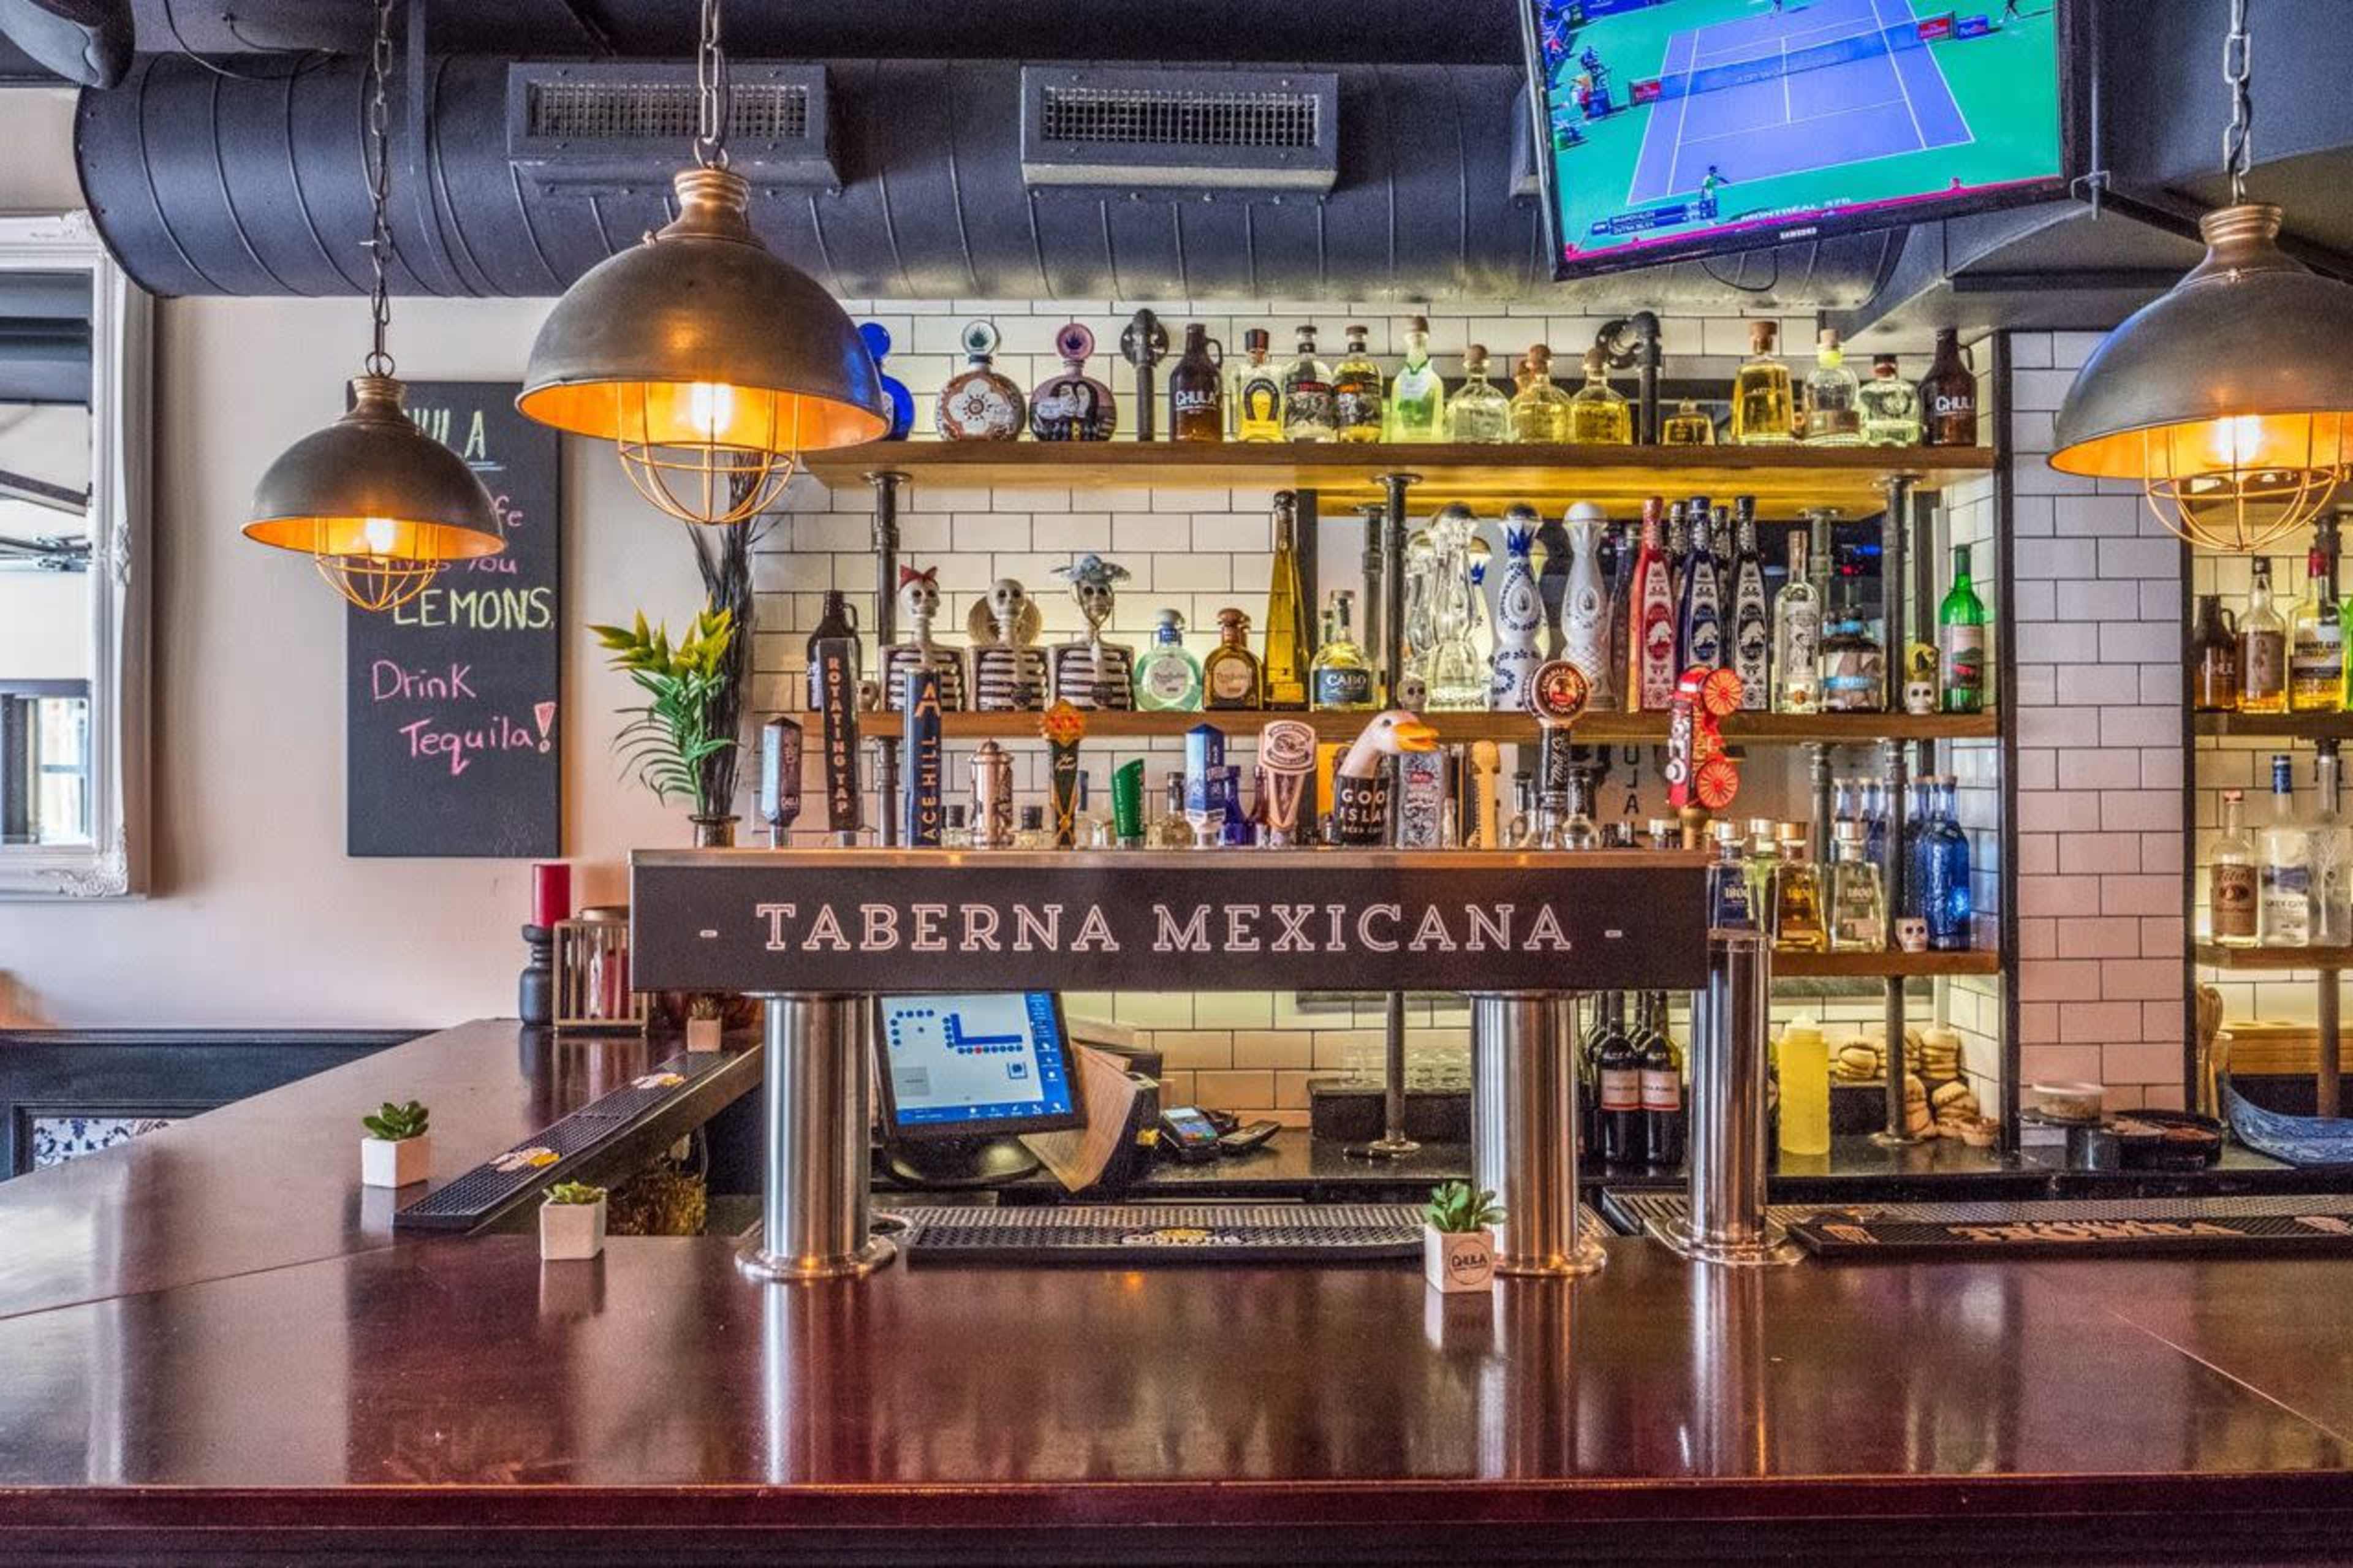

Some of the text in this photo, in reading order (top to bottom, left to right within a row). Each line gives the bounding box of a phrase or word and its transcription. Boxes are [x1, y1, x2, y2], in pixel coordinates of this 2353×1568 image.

[1176, 391, 1216, 405] CHULA
[399, 702, 556, 775] Tequila!
[921, 736, 937, 841] ACE HILL
[756, 904, 1120, 951] TABERNA
[1153, 904, 1571, 951] MEXICANA
